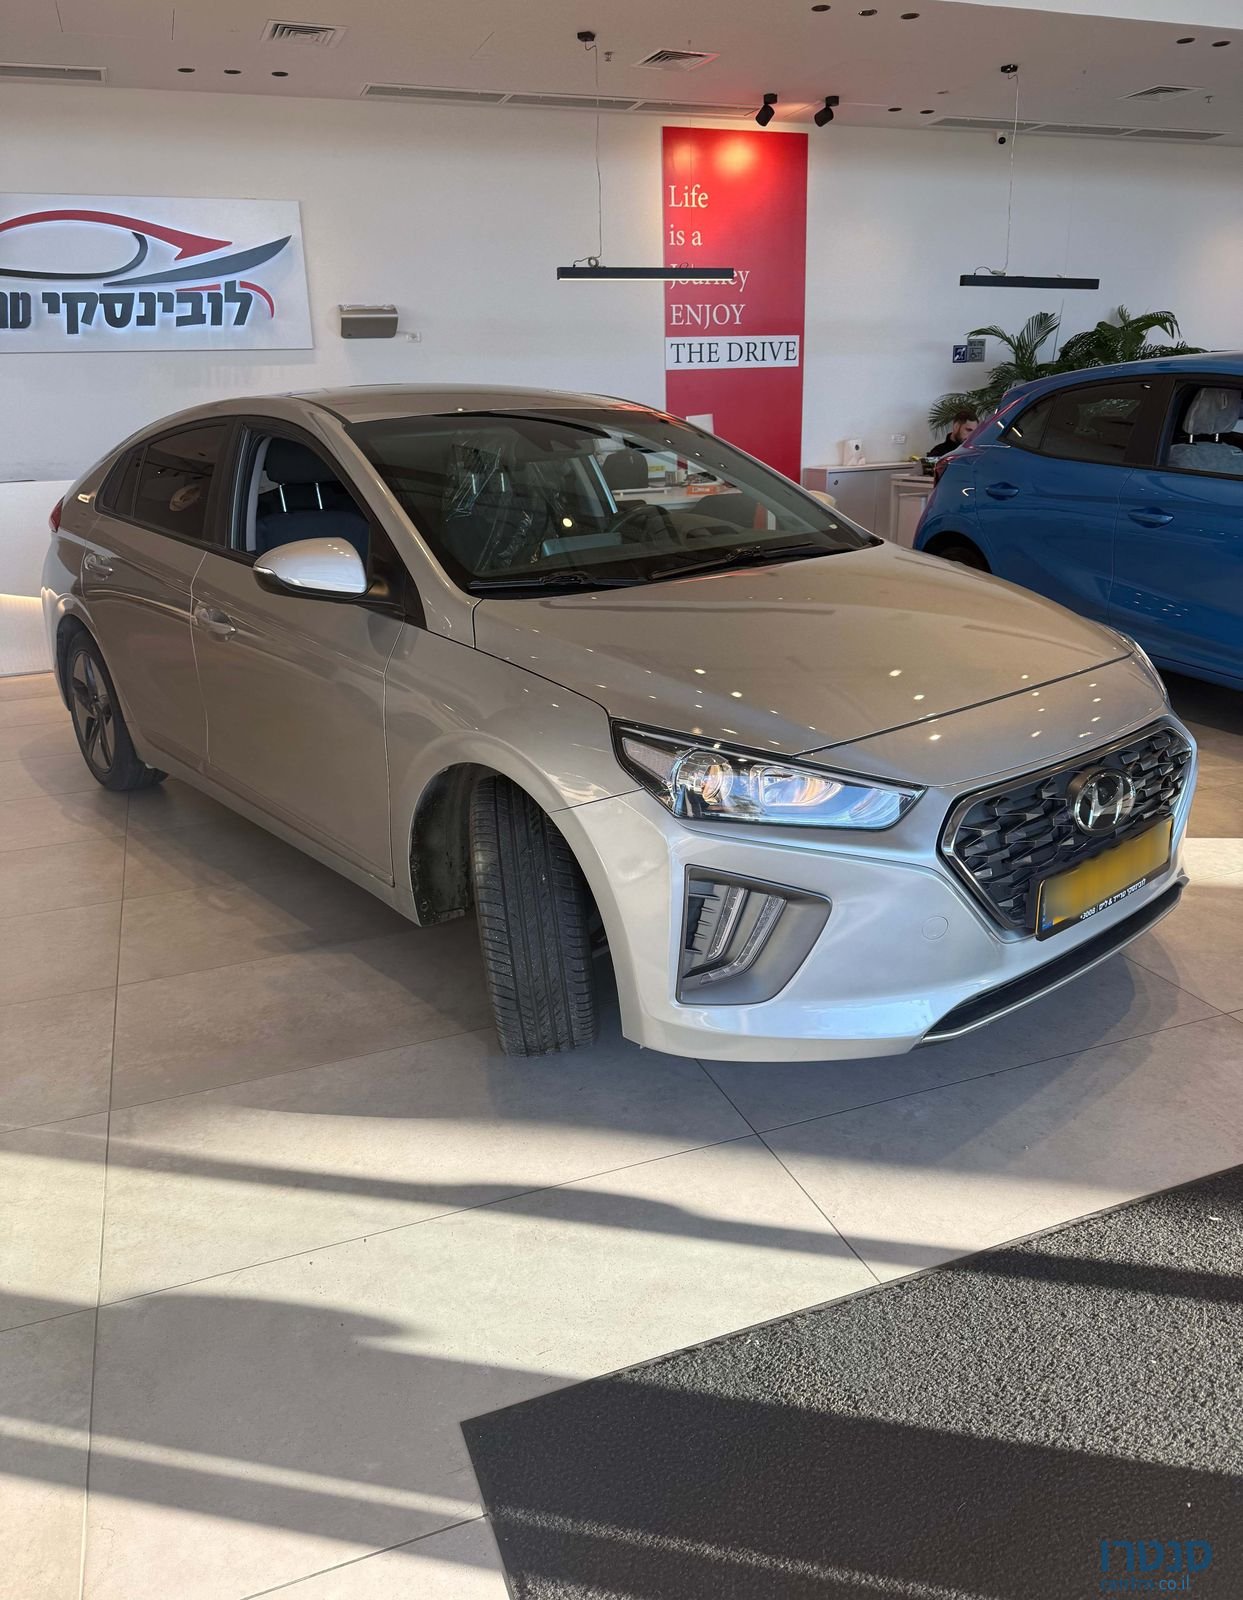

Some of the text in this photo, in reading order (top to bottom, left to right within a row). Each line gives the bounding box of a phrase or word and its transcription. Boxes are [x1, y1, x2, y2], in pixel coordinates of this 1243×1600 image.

[669, 184, 709, 208] Life
[669, 224, 703, 246] is a
[42, 280, 253, 335] לובינסקי
[670, 304, 746, 329] ENJOY
[670, 341, 797, 364] THE DRIVE
